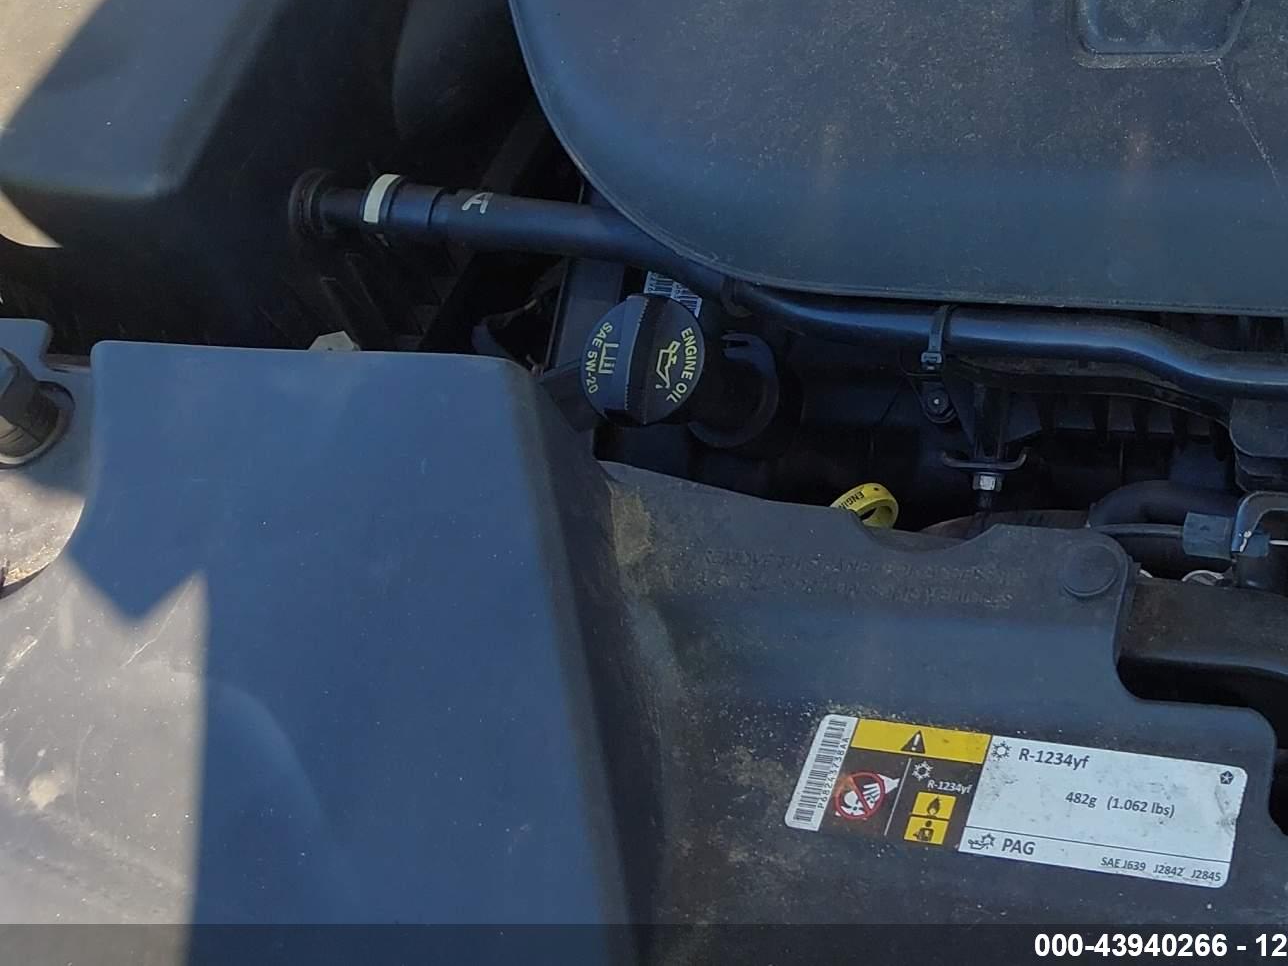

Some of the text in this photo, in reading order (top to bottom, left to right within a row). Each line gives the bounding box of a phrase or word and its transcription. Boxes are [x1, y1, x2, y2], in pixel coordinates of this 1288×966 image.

[585, 321, 614, 395] SAE 5W-20
[666, 327, 698, 404] ENGINE OIL
[1018, 747, 1090, 771] R-1234yf
[926, 779, 972, 795] R-1234yf
[1065, 791, 1176, 818] 482g (1.062 lbs)
[1001, 837, 1036, 857] PAG
[1100, 855, 1222, 882] SAE J639 J2842 J2845
